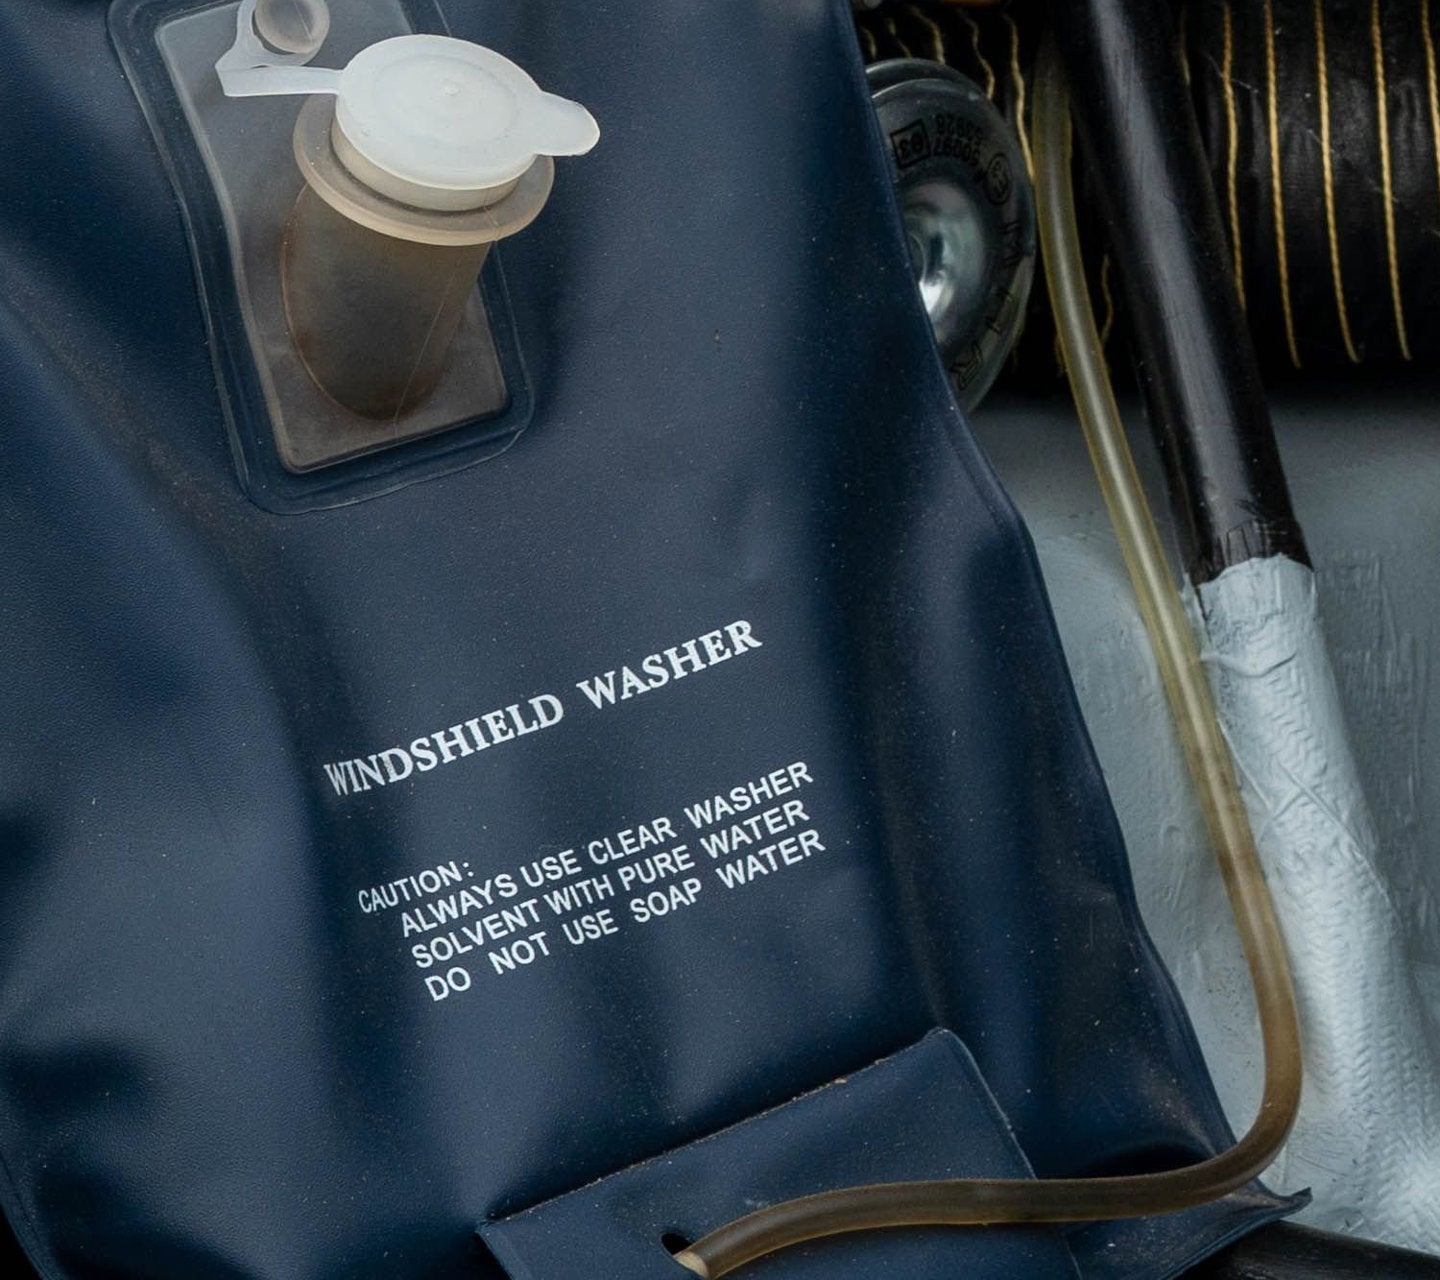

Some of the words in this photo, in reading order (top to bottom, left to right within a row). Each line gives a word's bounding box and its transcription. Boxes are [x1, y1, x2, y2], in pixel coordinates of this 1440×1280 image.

[323, 694, 563, 796] WINDSHIELD
[576, 620, 763, 709] WASHER
[358, 861, 473, 913] CAUTION:
[402, 874, 518, 937] ALWAYS
[520, 849, 582, 887] USE
[588, 817, 677, 864] CLEAR
[684, 762, 813, 828] WASHER
[412, 899, 540, 968] SOLVENT
[543, 875, 614, 914] WITH
[618, 845, 695, 890] PURE
[700, 800, 810, 858] WATER
[424, 967, 471, 1001] DO
[488, 932, 549, 974] NOT
[562, 909, 619, 944] USE
[630, 878, 701, 922] SOAP
[716, 829, 826, 888] WATER
